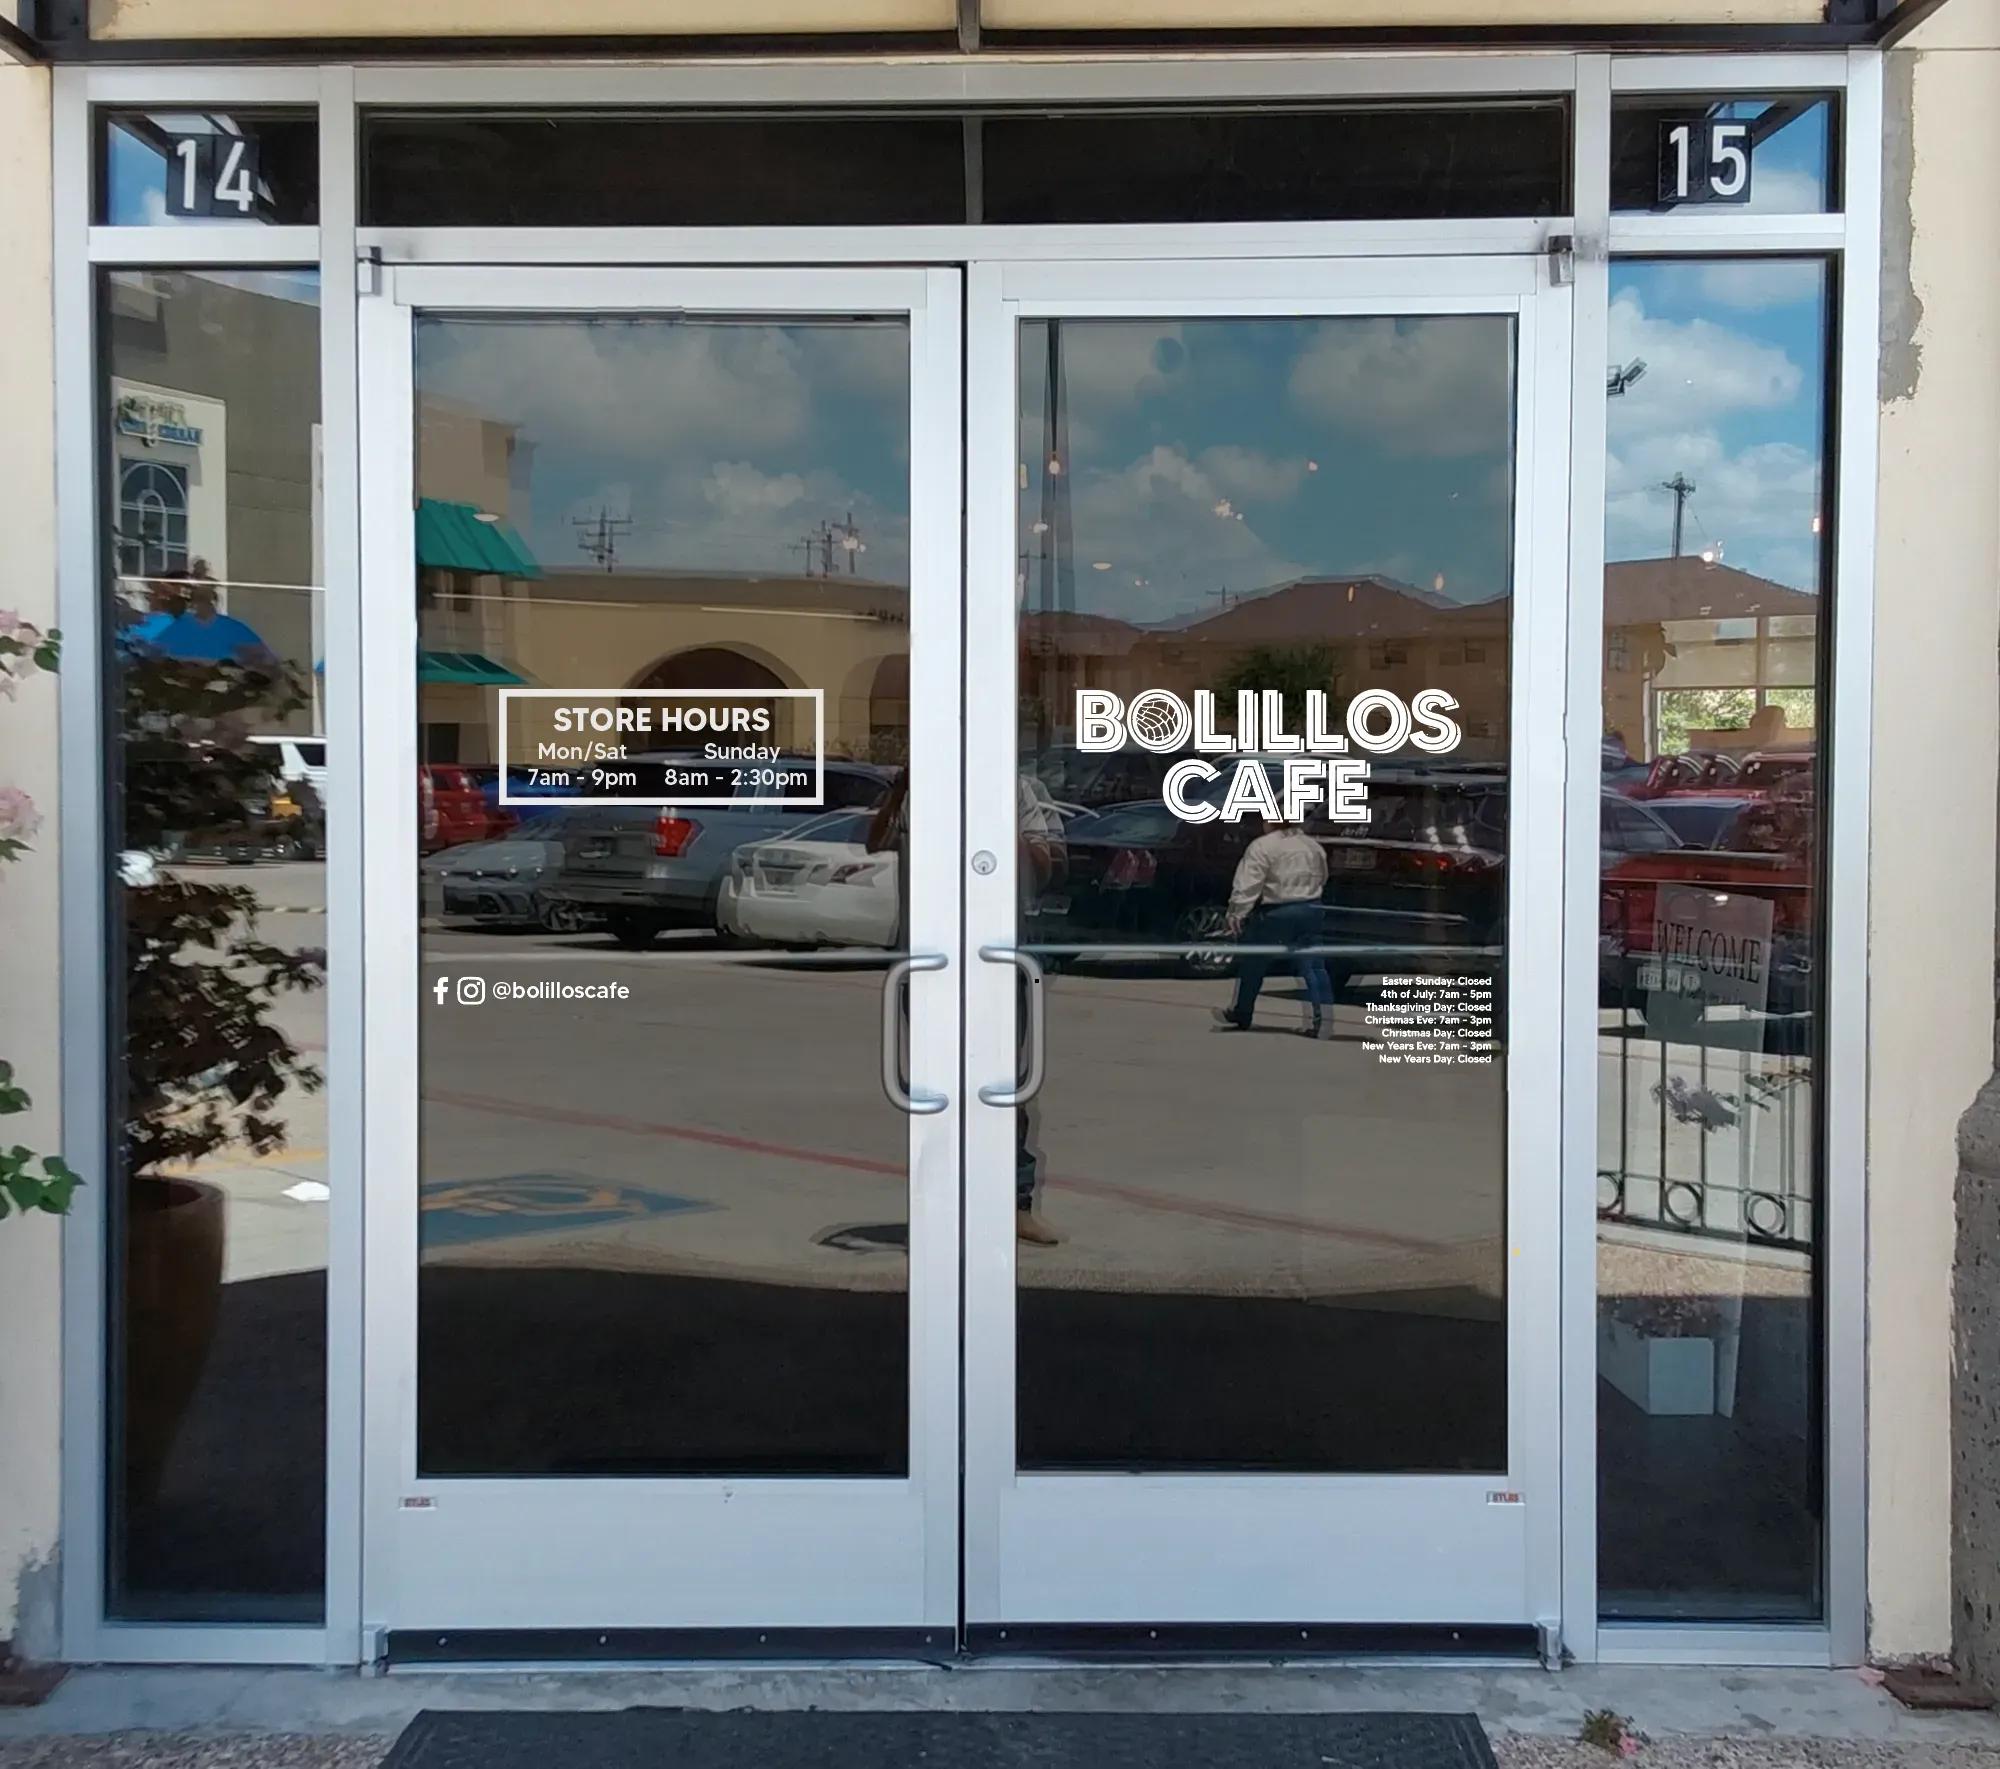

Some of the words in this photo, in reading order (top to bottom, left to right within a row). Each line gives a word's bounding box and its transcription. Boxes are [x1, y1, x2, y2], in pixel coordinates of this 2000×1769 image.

[1670, 125, 1746, 197] 15
[176, 138, 254, 212] 14
[554, 708, 652, 732] STORE
[662, 708, 770, 732] HOURS
[1076, 689, 1461, 754] BOLILLOS
[538, 742, 627, 762] Mon/Sat
[704, 743, 780, 763] Sunday
[528, 769, 570, 786] 7am
[592, 769, 636, 789] 9pm
[665, 769, 709, 786] 8am
[731, 769, 808, 789] 2:30pm
[1162, 759, 1371, 823] CAFE
[1657, 920, 1761, 984] WELCOME
[493, 981, 629, 999] @bolilloscafe
[1383, 976, 1412, 985] Easter
[1416, 976, 1455, 987] Sunday:
[1458, 976, 1491, 985] Closed
[1381, 989, 1397, 998] 4th
[1400, 989, 1410, 998] of
[1413, 989, 1436, 1000] July:
[1440, 989, 1459, 998] 7am
[1470, 989, 1491, 1000] 5pm
[1366, 1002, 1430, 1013] Thanksgiving
[1434, 1002, 1455, 1013] Day:
[1458, 1002, 1491, 1011] Closed
[1365, 1015, 1414, 1024] Christmas
[1417, 1015, 1436, 1024] Eve:
[1440, 1015, 1459, 1024] 7am
[1470, 1015, 1491, 1026] 3pm
[1382, 1028, 1430, 1037] Christmas
[1434, 1028, 1455, 1039] Day:
[1458, 1028, 1491, 1037] Closed
[1363, 1041, 1384, 1050] New
[1387, 1041, 1414, 1050] Years
[1417, 1041, 1436, 1050] Eve:
[1440, 1041, 1459, 1050] 7am
[1470, 1041, 1491, 1052] 3pm
[1379, 1054, 1401, 1063] New
[1404, 1054, 1430, 1063] Years
[1434, 1054, 1455, 1065] Day:
[1458, 1054, 1491, 1063] Closed
